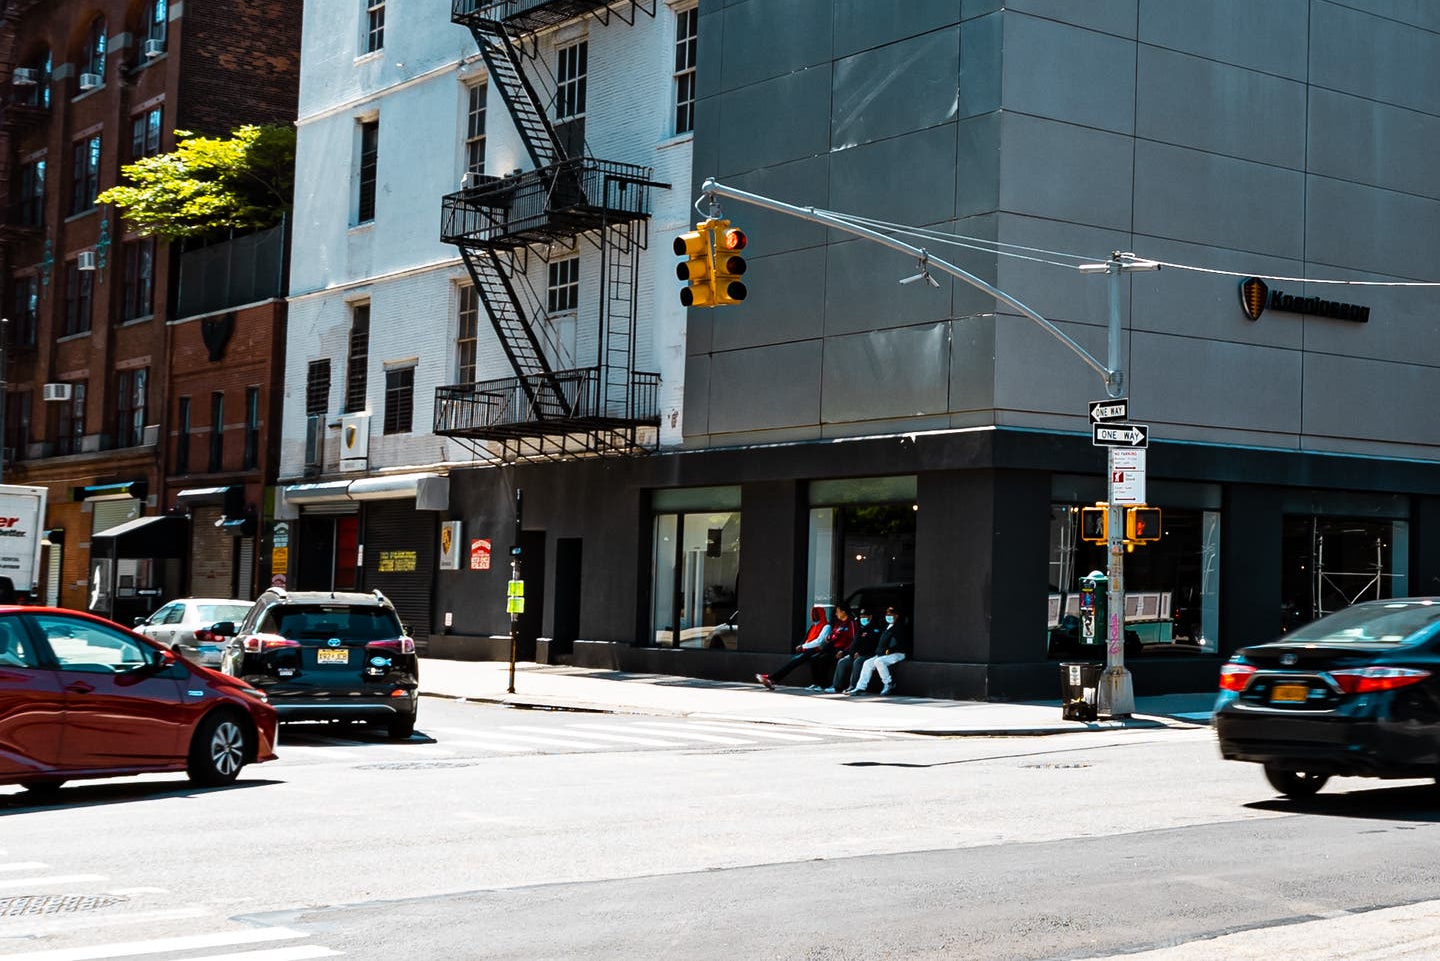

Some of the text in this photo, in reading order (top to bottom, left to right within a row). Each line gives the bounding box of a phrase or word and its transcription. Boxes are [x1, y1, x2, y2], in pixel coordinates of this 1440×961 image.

[1095, 406, 1123, 417] ONE WAY
[1101, 430, 1139, 440] ONE WAY
